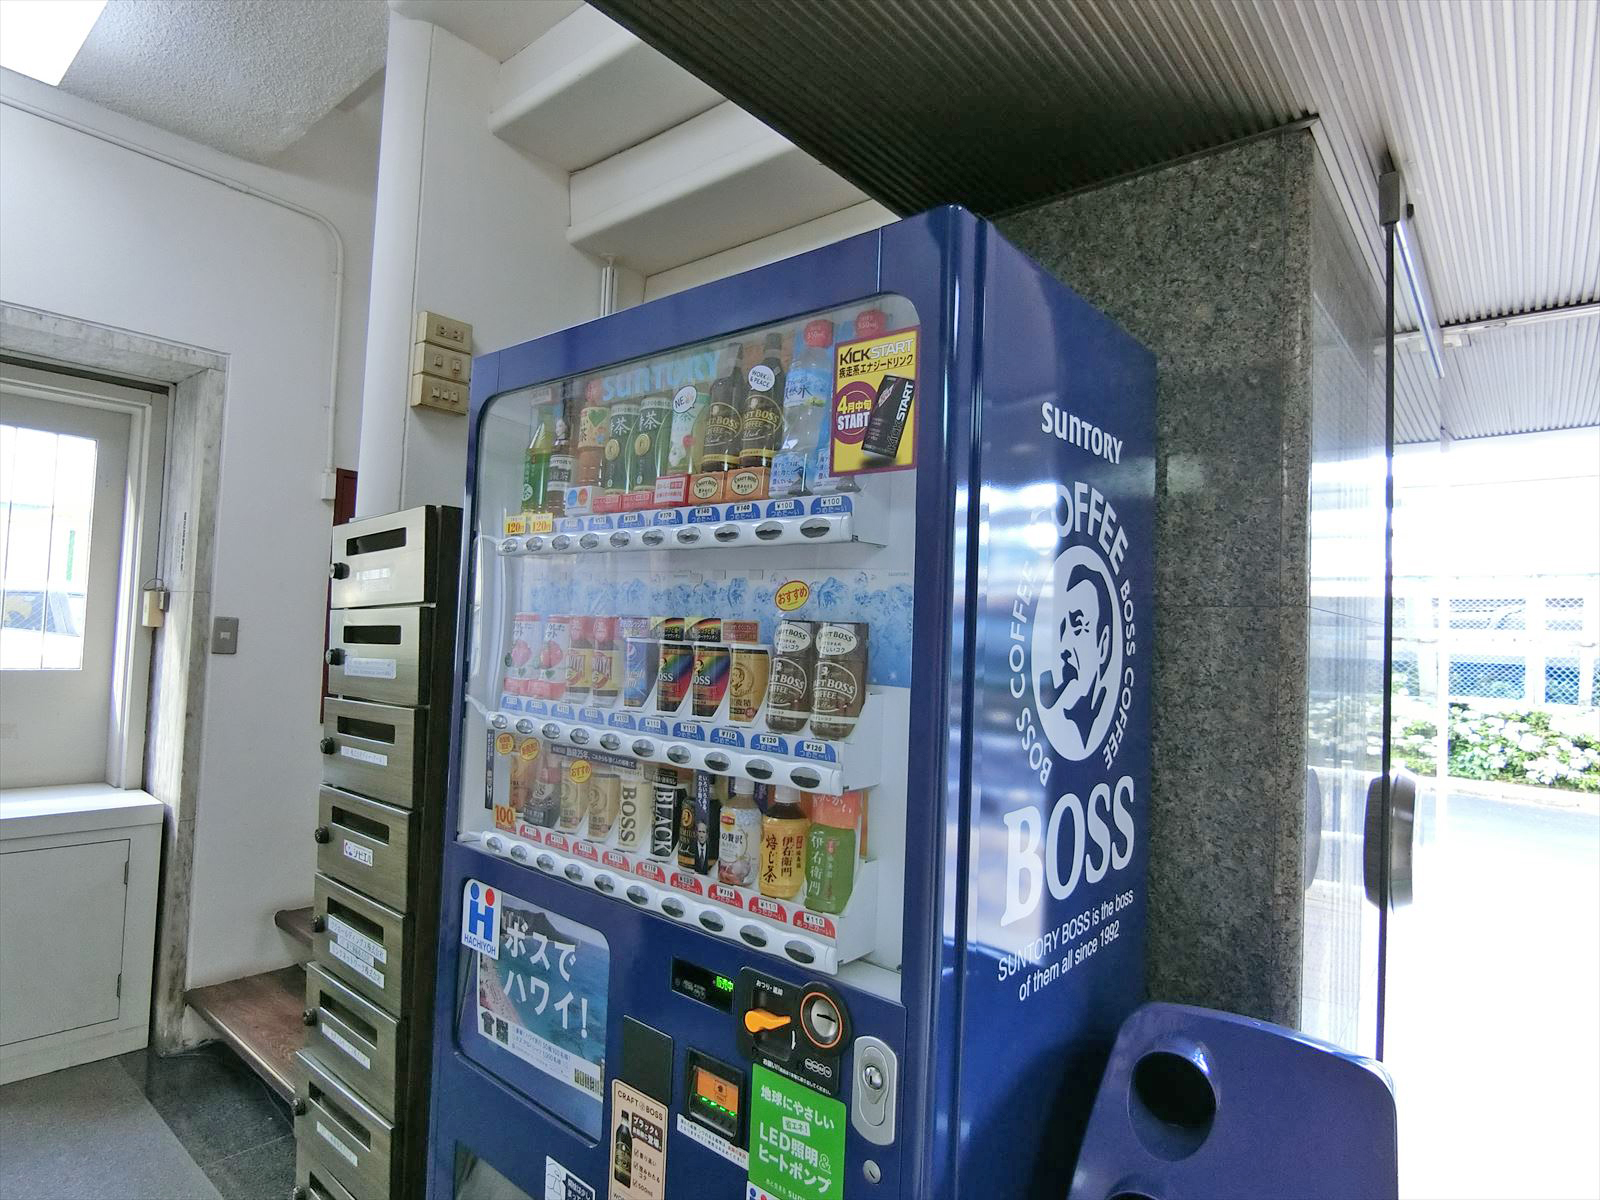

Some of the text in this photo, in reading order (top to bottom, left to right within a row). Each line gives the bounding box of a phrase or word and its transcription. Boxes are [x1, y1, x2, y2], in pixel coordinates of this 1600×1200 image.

[839, 354, 914, 379] 疾走系エナジードリンク
[755, 410, 779, 423] BOSS
[837, 395, 871, 414] 4月中旬
[717, 416, 739, 430] BOSS
[837, 412, 870, 431] START
[1041, 401, 1124, 465] SUNTORY
[778, 586, 808, 604] おすすめ
[789, 628, 807, 640] BOSS
[833, 631, 854, 643] BOSS
[780, 674, 805, 690] BOSS
[827, 679, 855, 694] BOSS
[1103, 579, 1136, 771] BOSS COFFEE
[682, 725, 696, 733] ¥110
[721, 730, 736, 739] ¥110
[762, 736, 777, 744] ¥120
[806, 743, 823, 751] ¥120
[1016, 707, 1053, 787] BOSS
[496, 805, 514, 825] 100
[621, 786, 637, 843] BOSS
[654, 788, 674, 855] BLACK
[763, 834, 778, 883] 焙じ茶
[781, 836, 793, 878] 伊右衛門
[1001, 775, 1135, 927] BOSS
[809, 831, 825, 896] 伊右衛門
[806, 915, 824, 925] ¥110
[464, 933, 496, 956] HACHIYOH
[998, 889, 1134, 982] SUNTORY BOSS is the boss
[505, 921, 577, 983] ボスで
[1018, 920, 1121, 1002] of them all since 1992
[715, 975, 734, 992] 販売中
[503, 970, 588, 1039] ハワイ!
[617, 1090, 663, 1121] CRAFT BOSS
[761, 1084, 834, 1129] 地球にやさしい
[759, 1143, 832, 1193] ヒートポンプ
